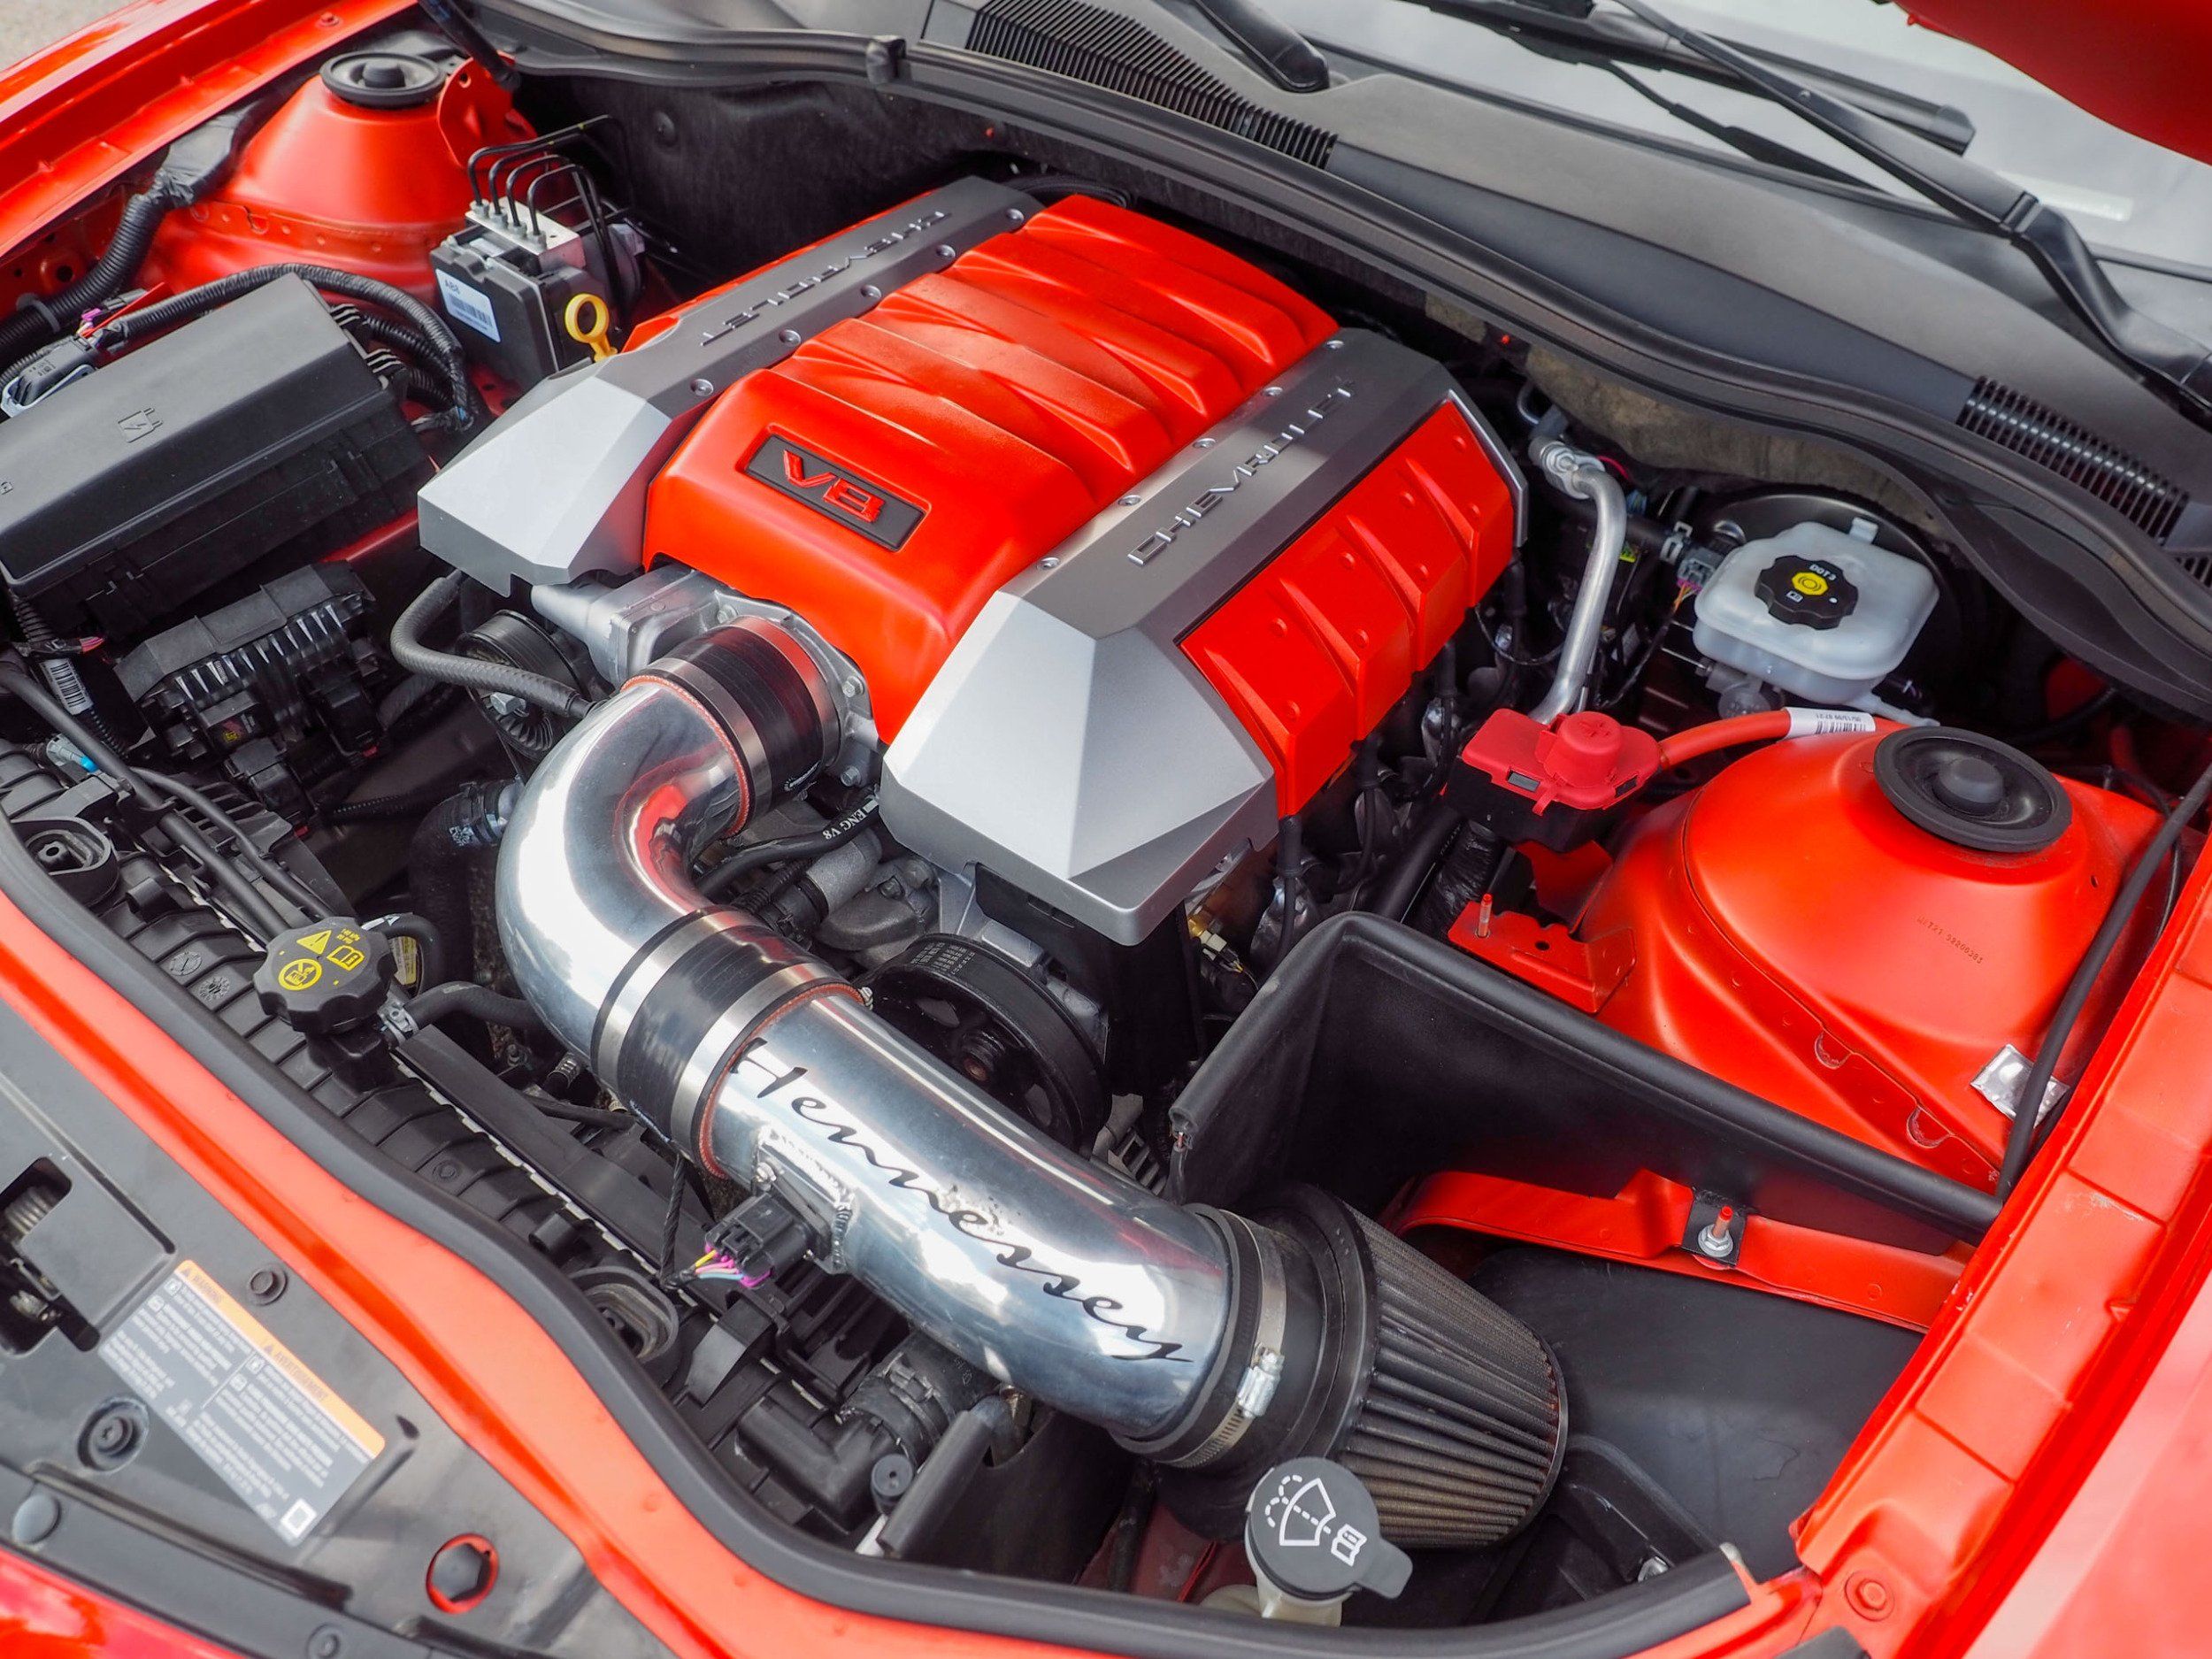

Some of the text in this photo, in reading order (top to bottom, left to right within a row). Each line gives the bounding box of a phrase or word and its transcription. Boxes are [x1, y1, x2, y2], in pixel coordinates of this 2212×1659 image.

[701, 211, 952, 346] CHEVROLET
[783, 449, 886, 524] V8
[1127, 377, 1356, 566] CHEVROLET
[822, 809, 867, 840] ENG V8
[729, 1036, 1195, 1363] Hennessey
